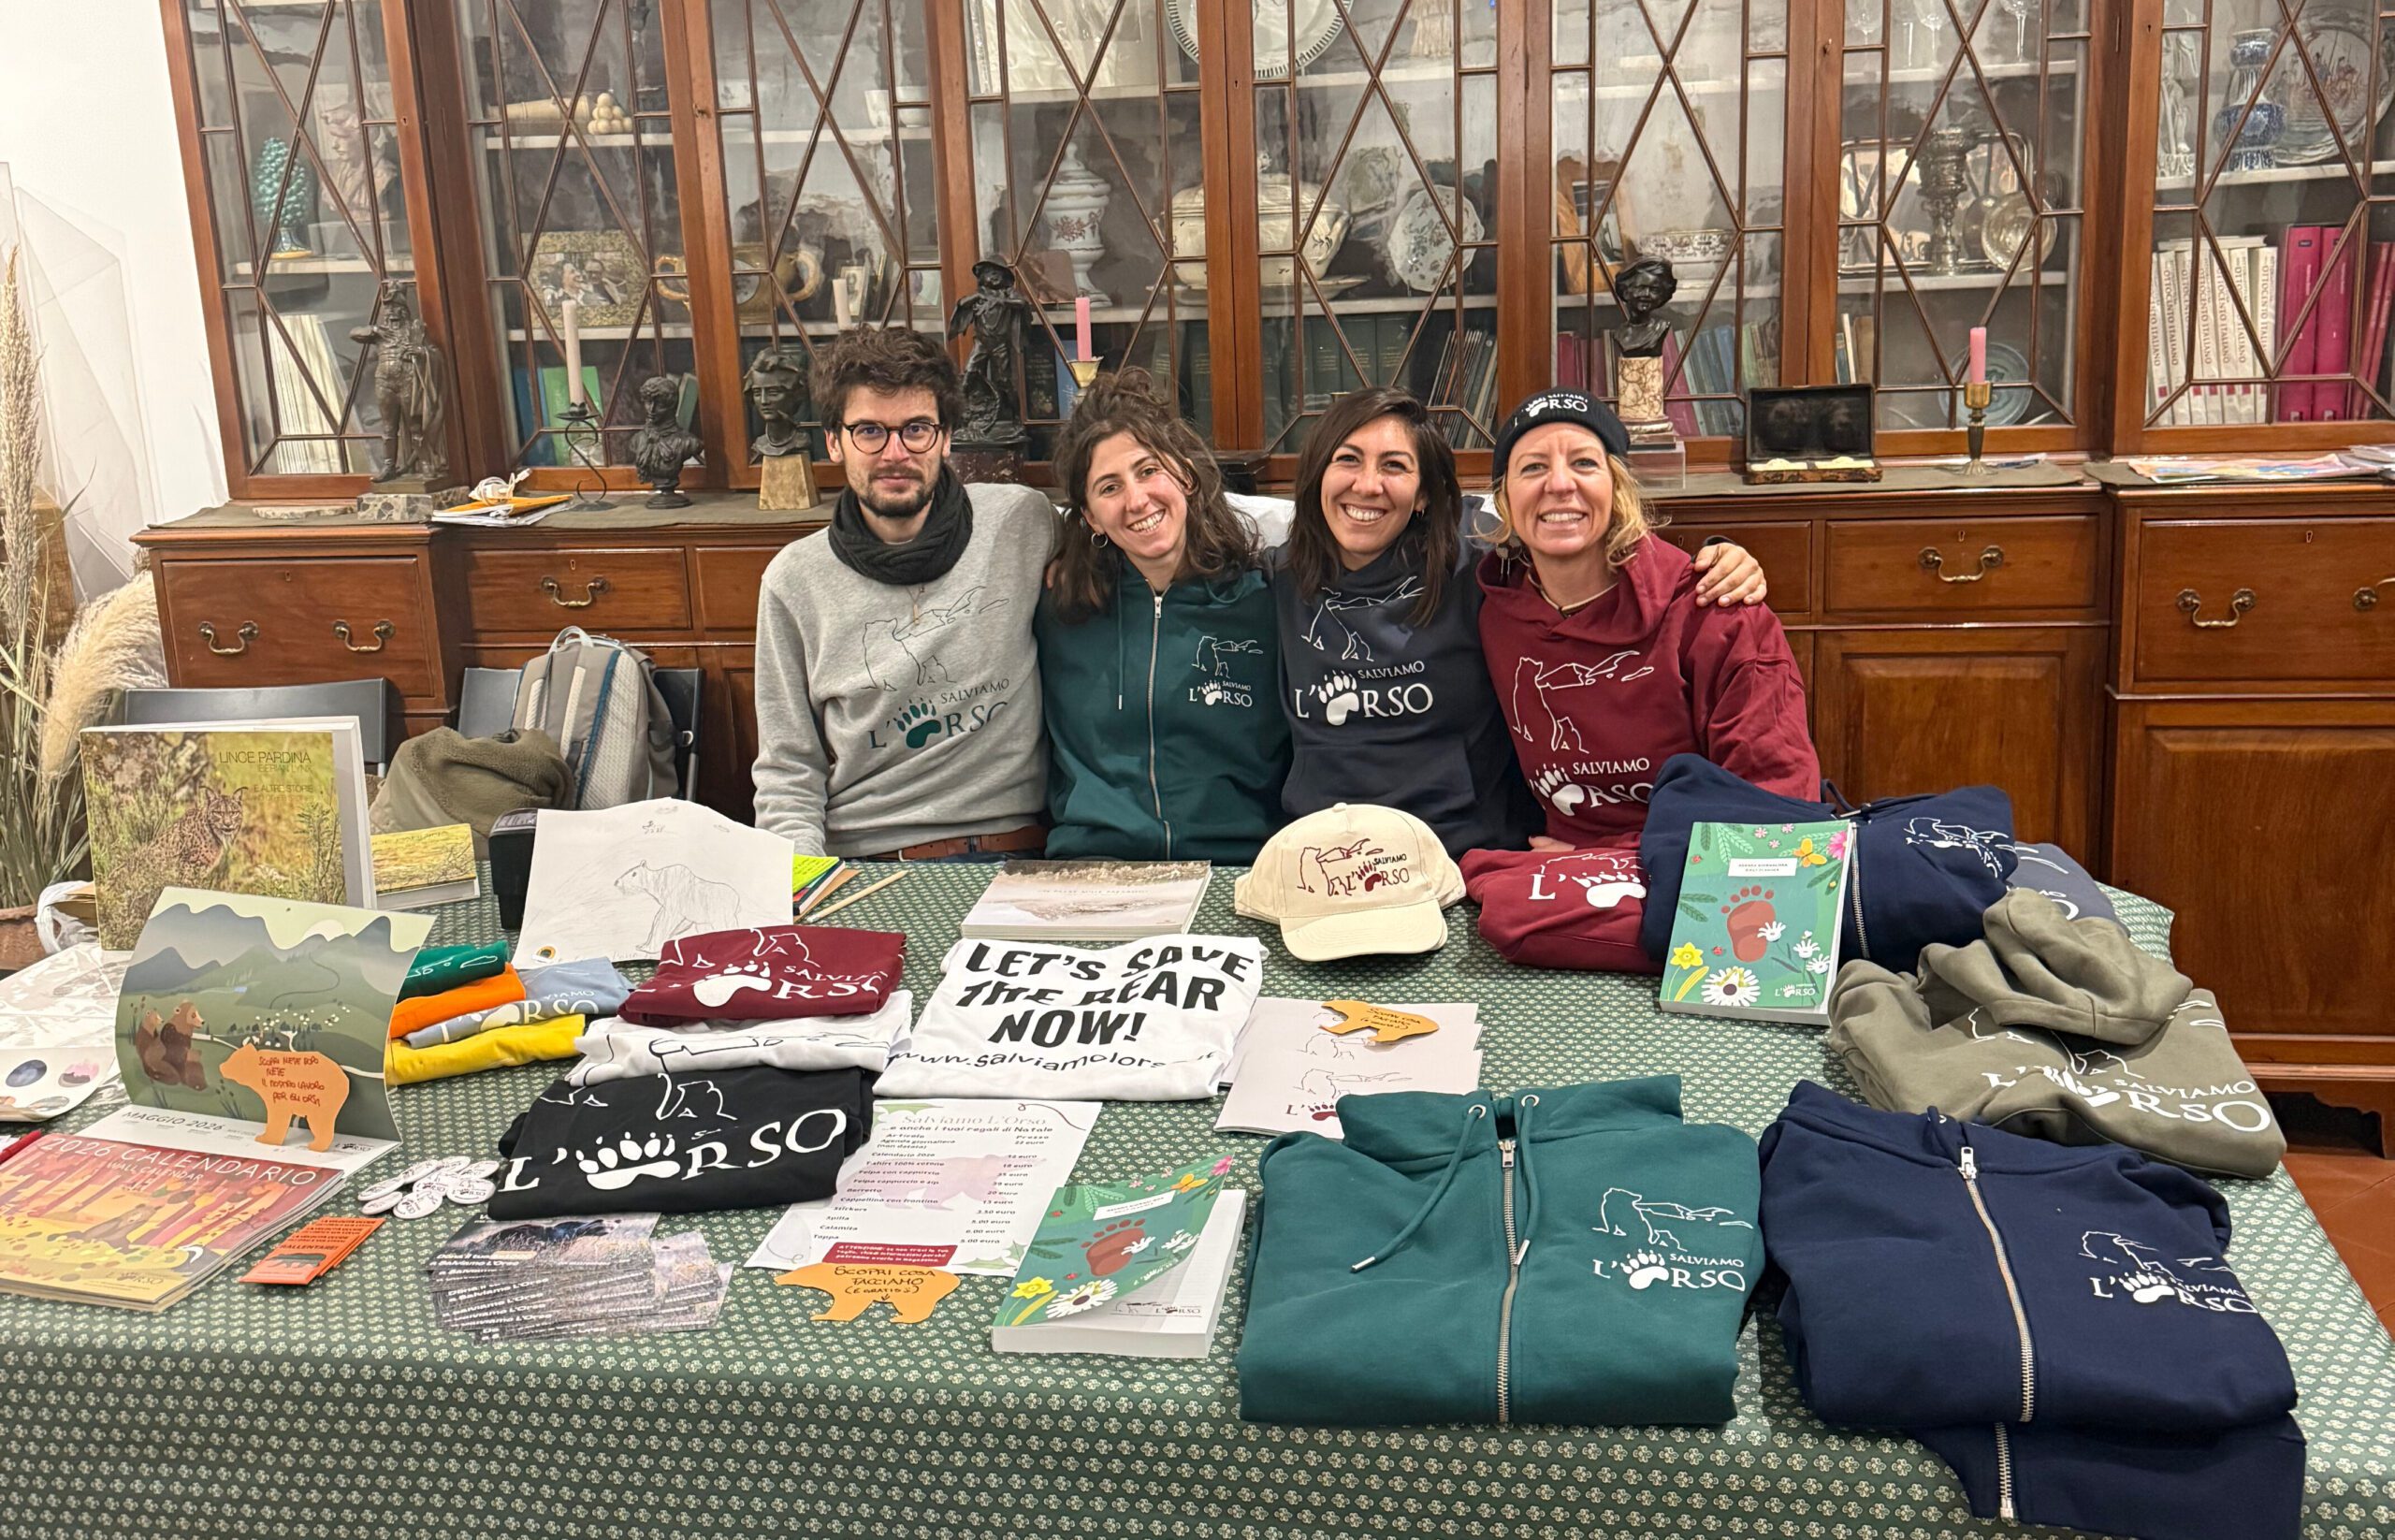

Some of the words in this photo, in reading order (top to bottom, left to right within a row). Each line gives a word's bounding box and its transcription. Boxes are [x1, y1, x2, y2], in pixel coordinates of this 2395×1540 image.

[1357, 660, 1426, 680] SALVIAMO
[940, 678, 1010, 705] SALVIAMO
[1222, 680, 1252, 691] SALVIAMO
[219, 750, 255, 763] LINCE
[257, 750, 312, 763] PARDINA
[1573, 757, 1651, 777] SALVIAMO
[965, 941, 1108, 981] LET'S
[1121, 945, 1256, 982] SAVE
[955, 980, 1065, 1008] THE
[1072, 970, 1227, 1012] BEAR
[987, 1009, 1148, 1049] NOW!
[272, 1092, 287, 1104] PER
[2113, 1078, 2257, 1100] SALVIAMO
[122, 1111, 186, 1127] MAGGIO
[186, 1118, 226, 1133] 2026
[902, 1114, 983, 1125] Salviamo
[987, 1114, 1048, 1126] L'Orso
[966, 1126, 1000, 1134] regali
[43, 1137, 113, 1158] 2026
[122, 1146, 317, 1186] CALENDARIO
[106, 1160, 141, 1175] WALL
[139, 1165, 205, 1184] CALENDAR
[834, 1265, 893, 1276] SCOPRI
[1669, 1252, 1745, 1268] SALVIAMO
[458, 1286, 512, 1300] Salviamo
[513, 1277, 549, 1289] L'Orso
